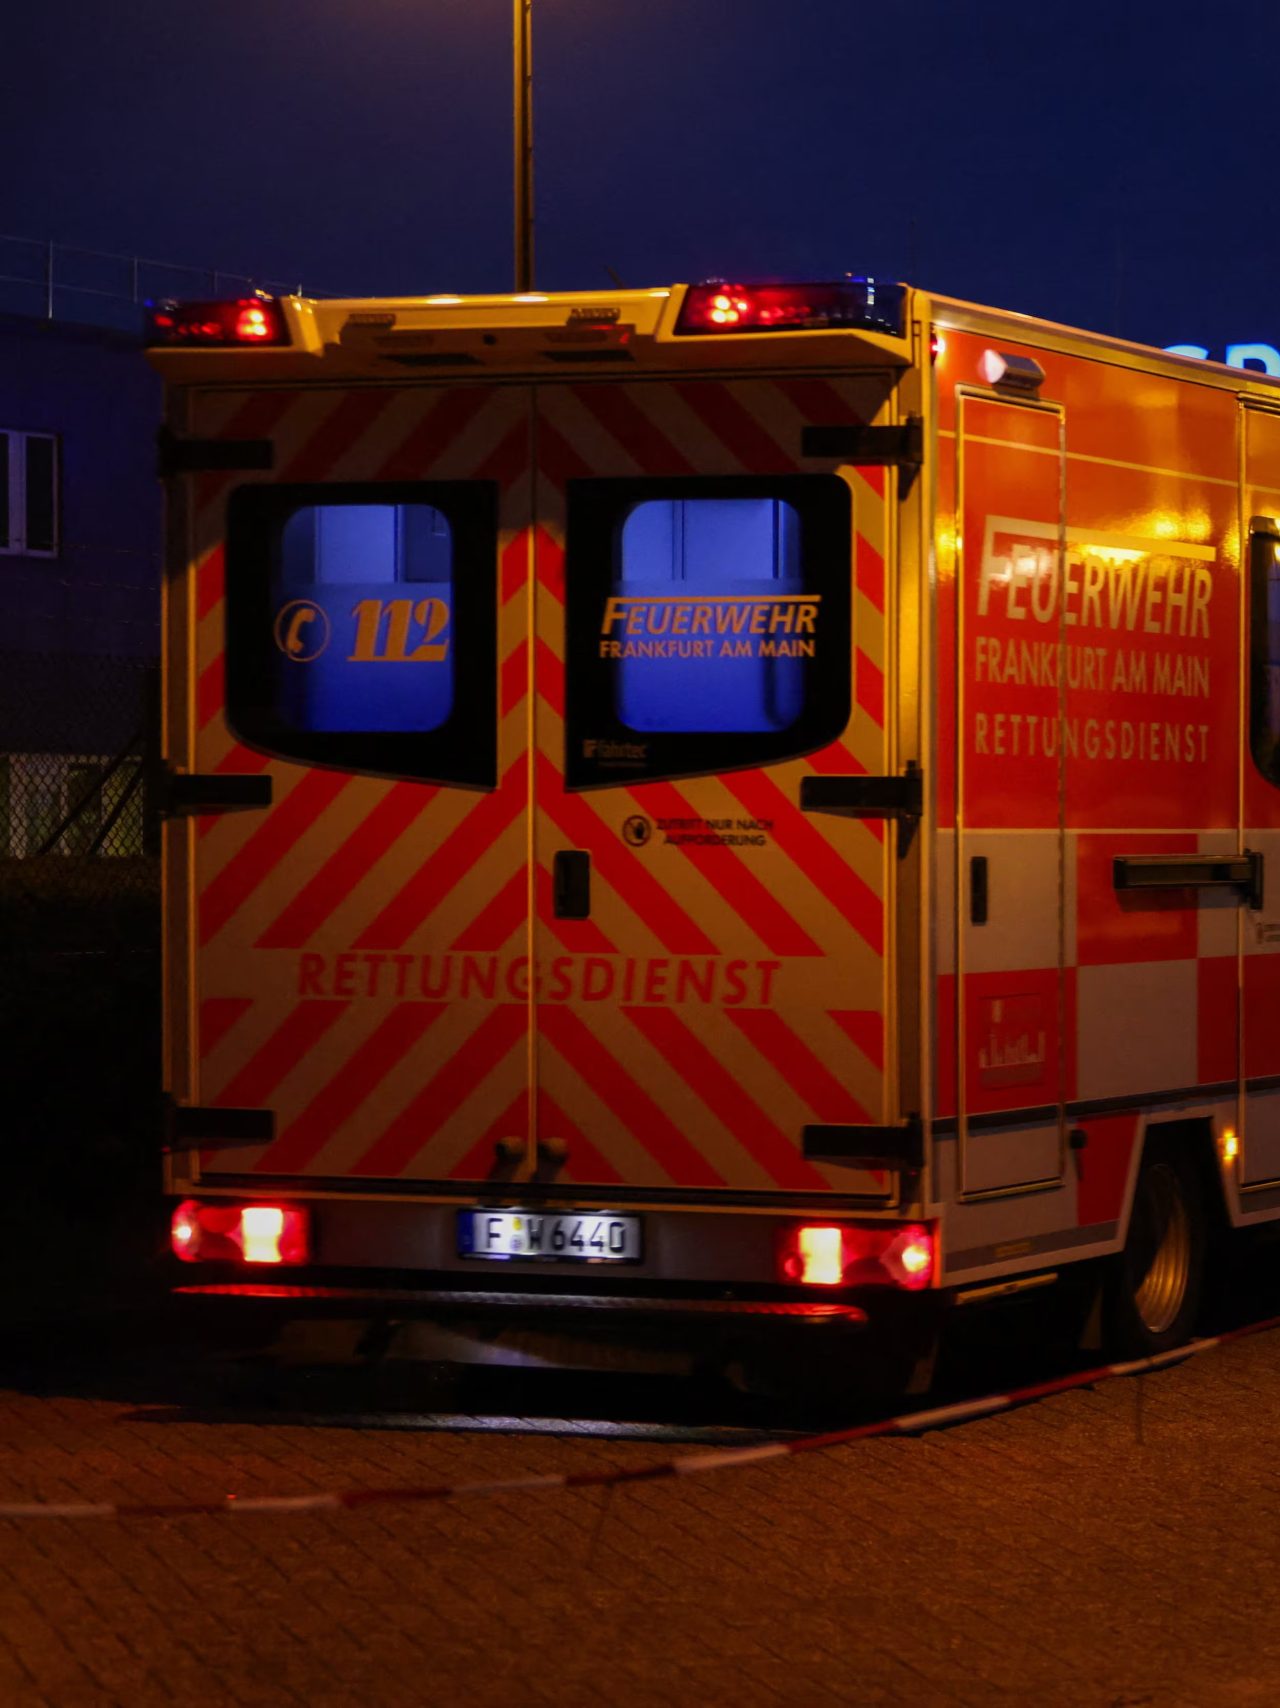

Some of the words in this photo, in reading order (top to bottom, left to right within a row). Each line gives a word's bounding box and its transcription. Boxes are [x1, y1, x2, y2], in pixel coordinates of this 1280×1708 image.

[976, 514, 1216, 639] FEUERWEHR
[346, 598, 450, 662] 112
[601, 595, 822, 635] FEUERWEHR
[599, 639, 715, 659] FRANKFURT
[719, 639, 752, 658] AM
[758, 638, 816, 658] MAIN
[975, 635, 1107, 690] FRANKFURT
[1111, 648, 1148, 694] AM
[1153, 652, 1210, 699] MAIN
[975, 712, 1210, 763] RETTUNGSDIENST
[300, 953, 780, 1005] RETTUNGSDIENST
[487, 1217, 503, 1249] F
[552, 1219, 625, 1253] 6440
